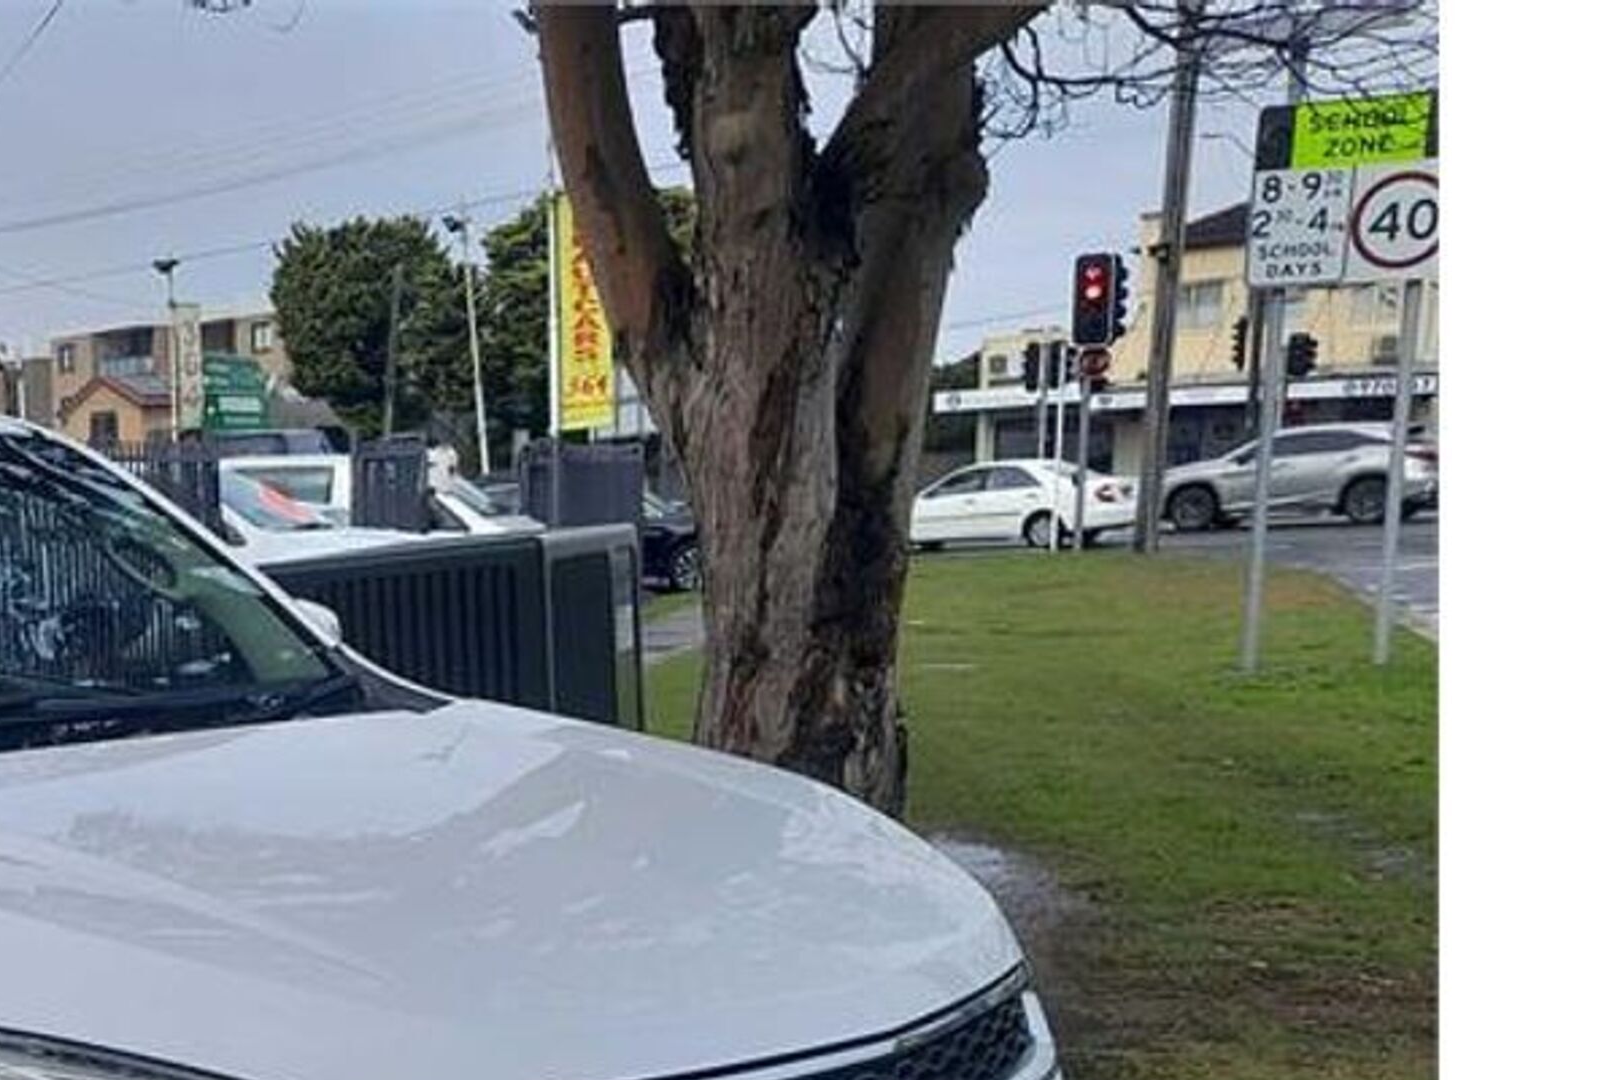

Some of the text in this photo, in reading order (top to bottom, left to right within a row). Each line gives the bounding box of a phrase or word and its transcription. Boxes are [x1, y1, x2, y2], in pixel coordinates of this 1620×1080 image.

[1323, 133, 1394, 158] ZONE
[1368, 198, 1438, 242] 40
[1257, 242, 1332, 261] SCHOOL
[1265, 262, 1322, 279] DAYS
